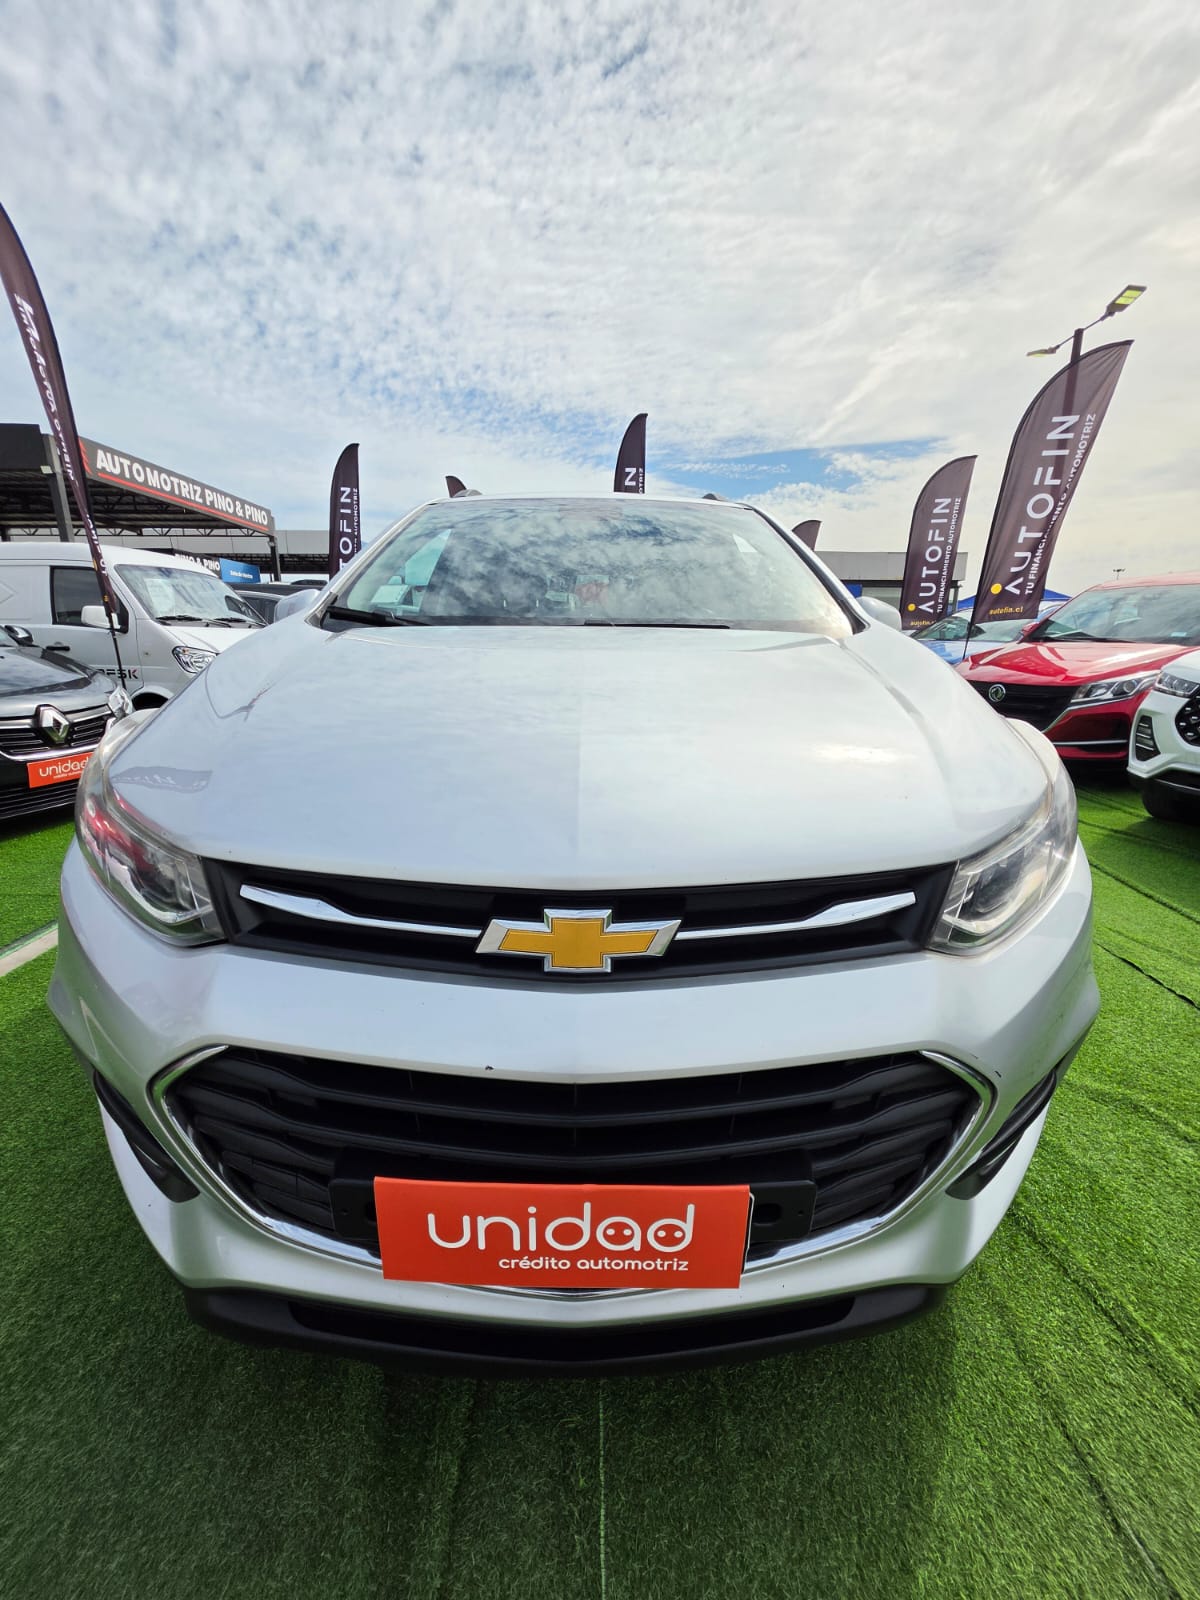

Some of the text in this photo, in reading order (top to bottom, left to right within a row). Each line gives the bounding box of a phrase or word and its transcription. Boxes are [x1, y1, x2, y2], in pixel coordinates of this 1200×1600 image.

[205, 487, 234, 514] PINO
[235, 501, 243, 517] &
[244, 504, 268, 526] PINO
[1004, 414, 1080, 595] AUTOFIN
[339, 487, 352, 571] TOFIN
[918, 498, 952, 614] AUTOFIN
[937, 604, 943, 613] TU
[949, 497, 961, 544] AUTOMOTRIZ
[989, 605, 1024, 615] autofin.cl
[1025, 582, 1035, 595] TU
[39, 756, 89, 777] unidad
[427, 1202, 696, 1252] unidad
[498, 1255, 689, 1272] crédito automotriz
